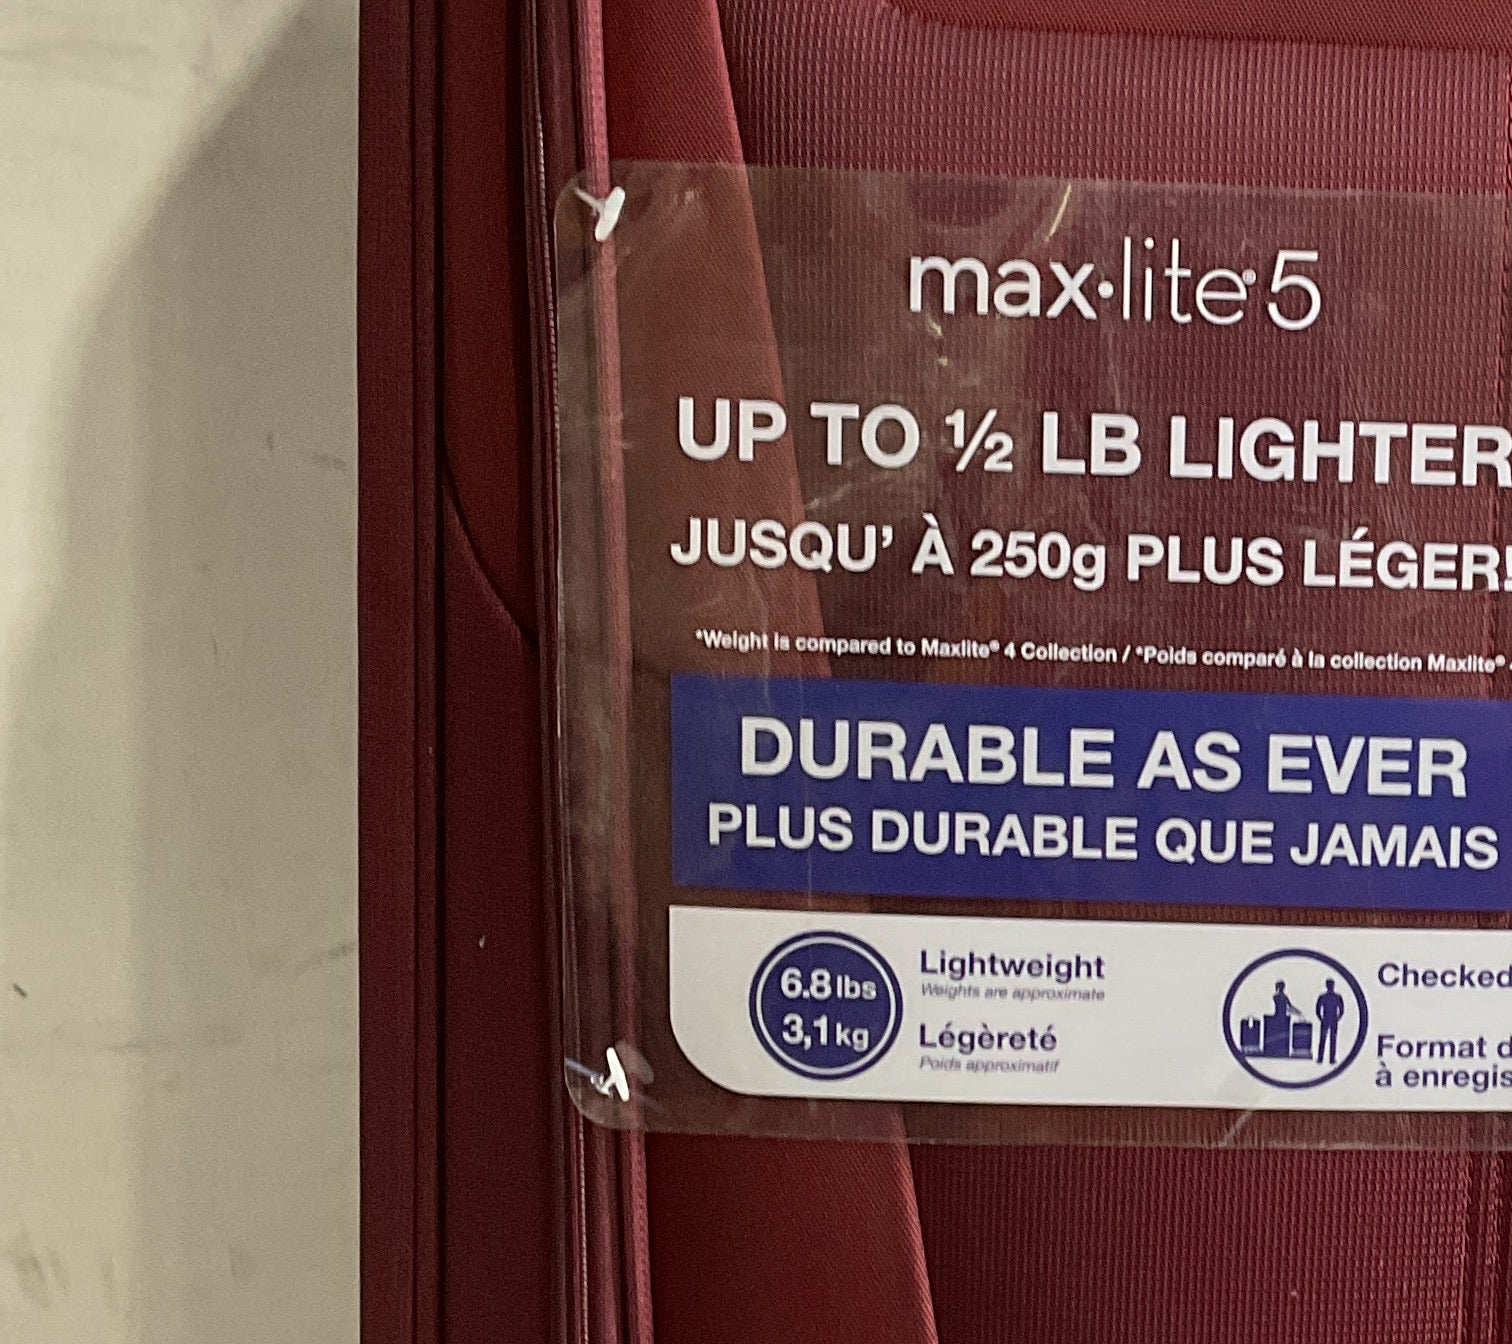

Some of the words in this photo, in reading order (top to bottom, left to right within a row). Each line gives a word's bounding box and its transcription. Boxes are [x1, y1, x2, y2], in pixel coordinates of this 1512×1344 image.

[679, 397, 786, 461] UP
[811, 402, 919, 467] TO
[1043, 412, 1141, 475] LB
[671, 517, 892, 572] JUSQU'
[912, 513, 954, 574] À
[971, 530, 1105, 590] 250g
[1128, 534, 1283, 585] PLUS
[774, 632, 789, 650] is
[796, 637, 891, 655] compared
[896, 638, 915, 655] to
[1004, 642, 1015, 659] 4
[1021, 642, 1117, 662] Collection
[1202, 648, 1286, 669] comparé
[1292, 648, 1303, 668] à
[1309, 650, 1324, 668] la
[1331, 651, 1422, 671] collection
[742, 717, 1114, 787] DURABLE
[1138, 731, 1241, 791] AS
[1269, 734, 1466, 797] EVER
[710, 803, 852, 850] PLUS
[872, 810, 1137, 859] DURABLE
[1156, 819, 1273, 864] QUE
[1290, 823, 1498, 869] JAMAIS
[781, 968, 831, 999] 6.8
[837, 975, 876, 999] lbs
[921, 950, 1104, 984] Lightweight
[922, 983, 979, 1000] Weights
[986, 988, 1007, 998] are
[1013, 989, 1105, 1001] approximate
[783, 1013, 827, 1049] 3,1
[836, 1023, 868, 1051] kg
[920, 1022, 1056, 1055] Légèreté
[1378, 1035, 1486, 1058] Format
[920, 1056, 961, 1070] Poids
[966, 1060, 1059, 1073] approximatif
[1376, 1061, 1391, 1087] à
